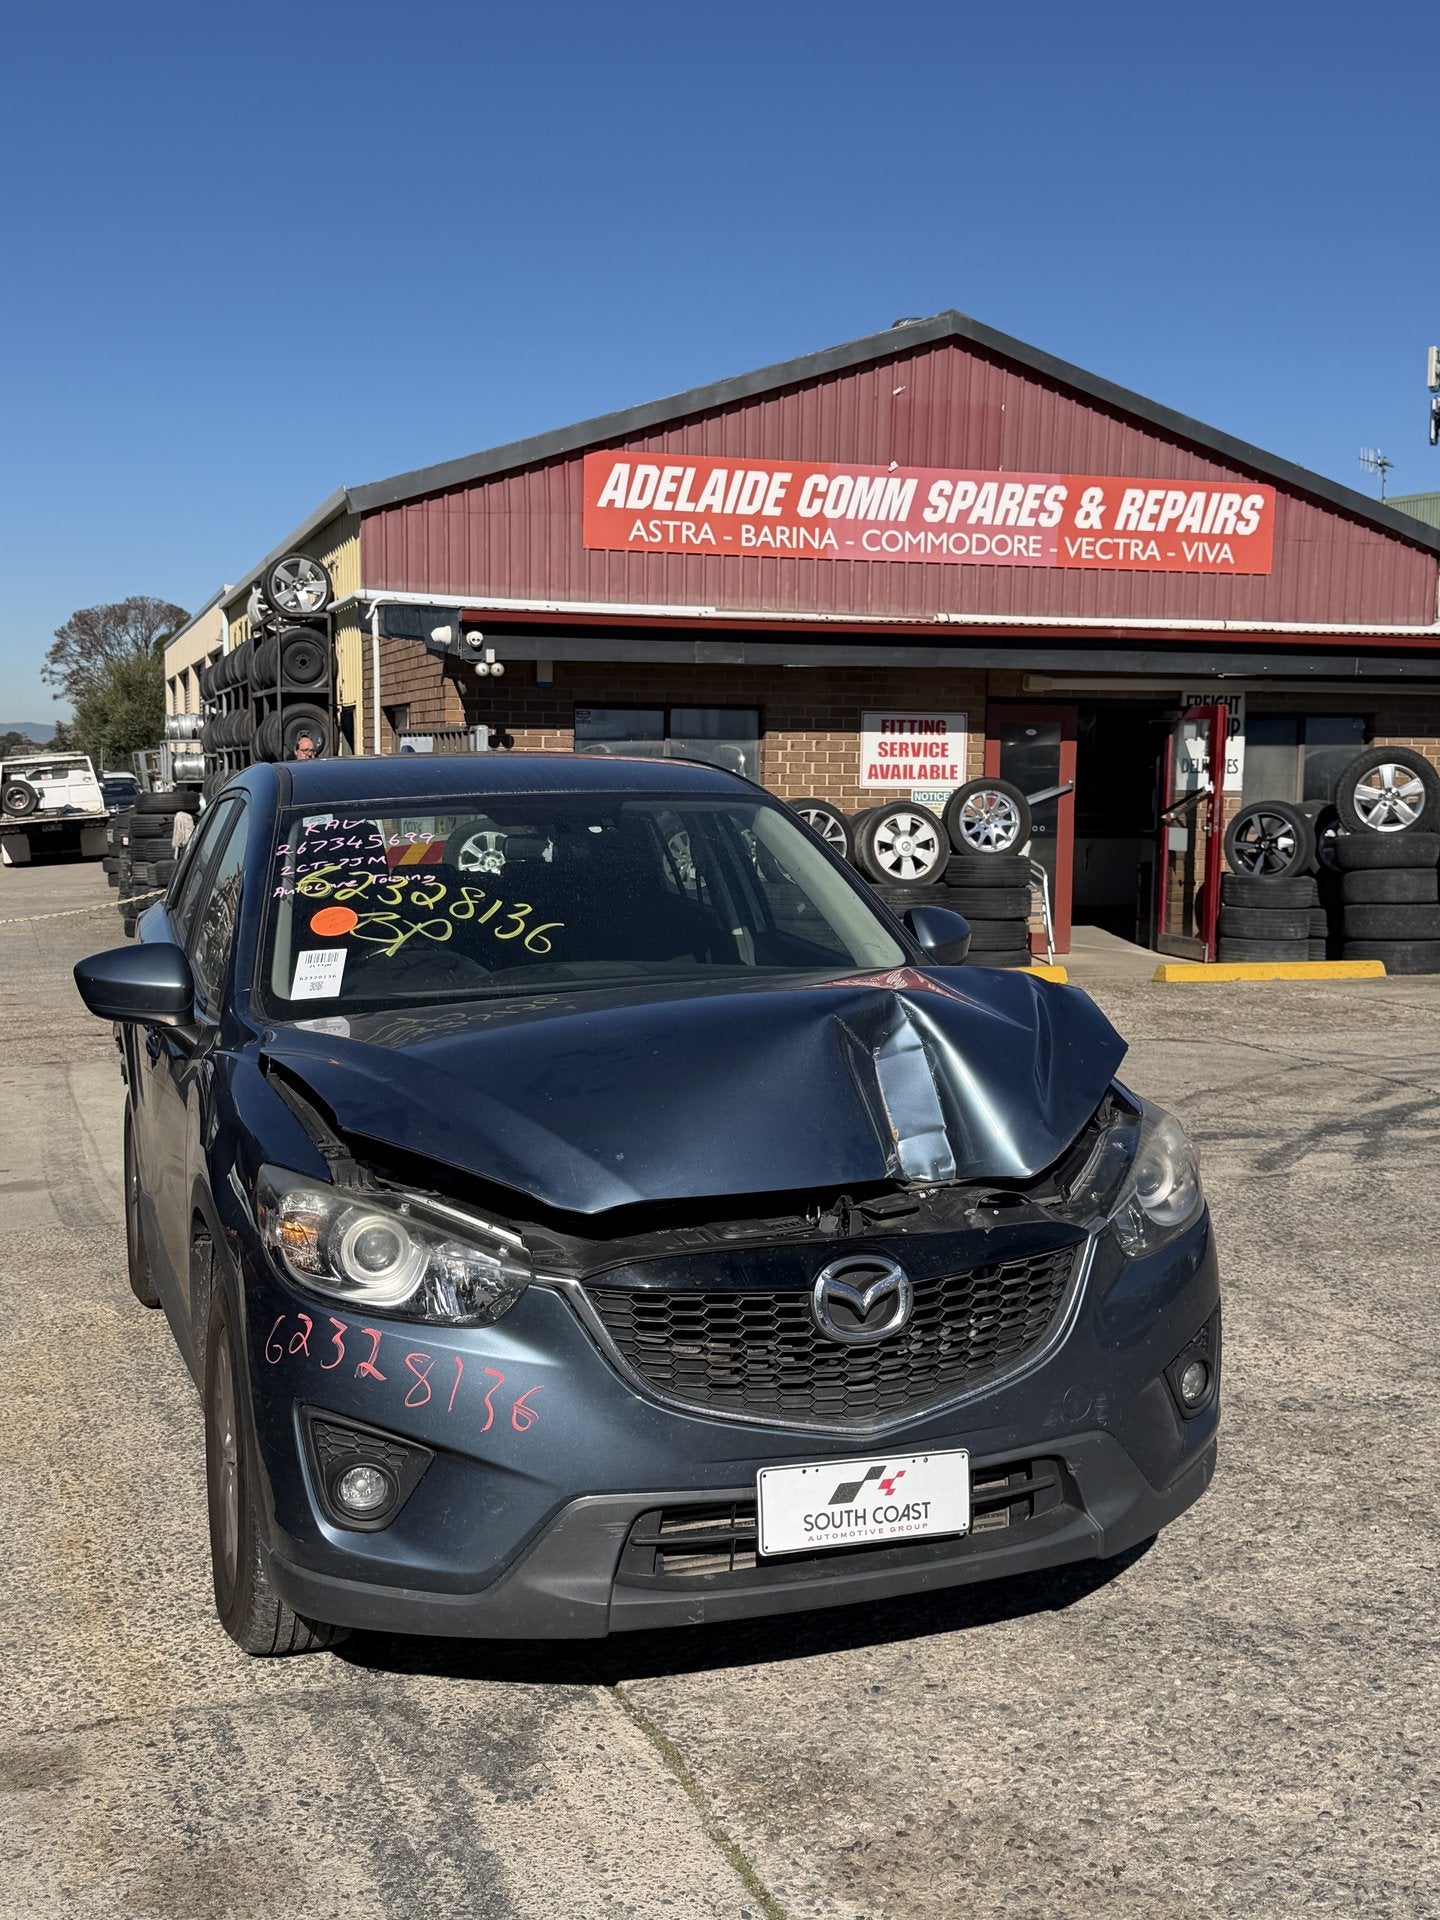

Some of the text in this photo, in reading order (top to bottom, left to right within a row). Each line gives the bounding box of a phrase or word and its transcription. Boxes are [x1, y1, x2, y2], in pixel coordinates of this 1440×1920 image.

[597, 463, 1264, 536] ADELAIDE COMM SPARES & REPAIRS
[629, 519, 716, 545] ASTRA
[741, 524, 839, 550] BARINA
[862, 529, 1042, 558] COMMODORE
[1064, 537, 1161, 562] VECTRA
[1182, 541, 1234, 564] VIVA
[881, 719, 947, 735] FITTING
[878, 741, 949, 758] SERVICE
[867, 764, 958, 780] AVAILABLE
[914, 792, 950, 801] NOTICE
[299, 866, 565, 953] 62328136
[265, 1313, 545, 1432] 62328136
[803, 1501, 931, 1532] SOUTH COAST
[807, 1522, 929, 1541] AUTOMOTIVE GROUP
